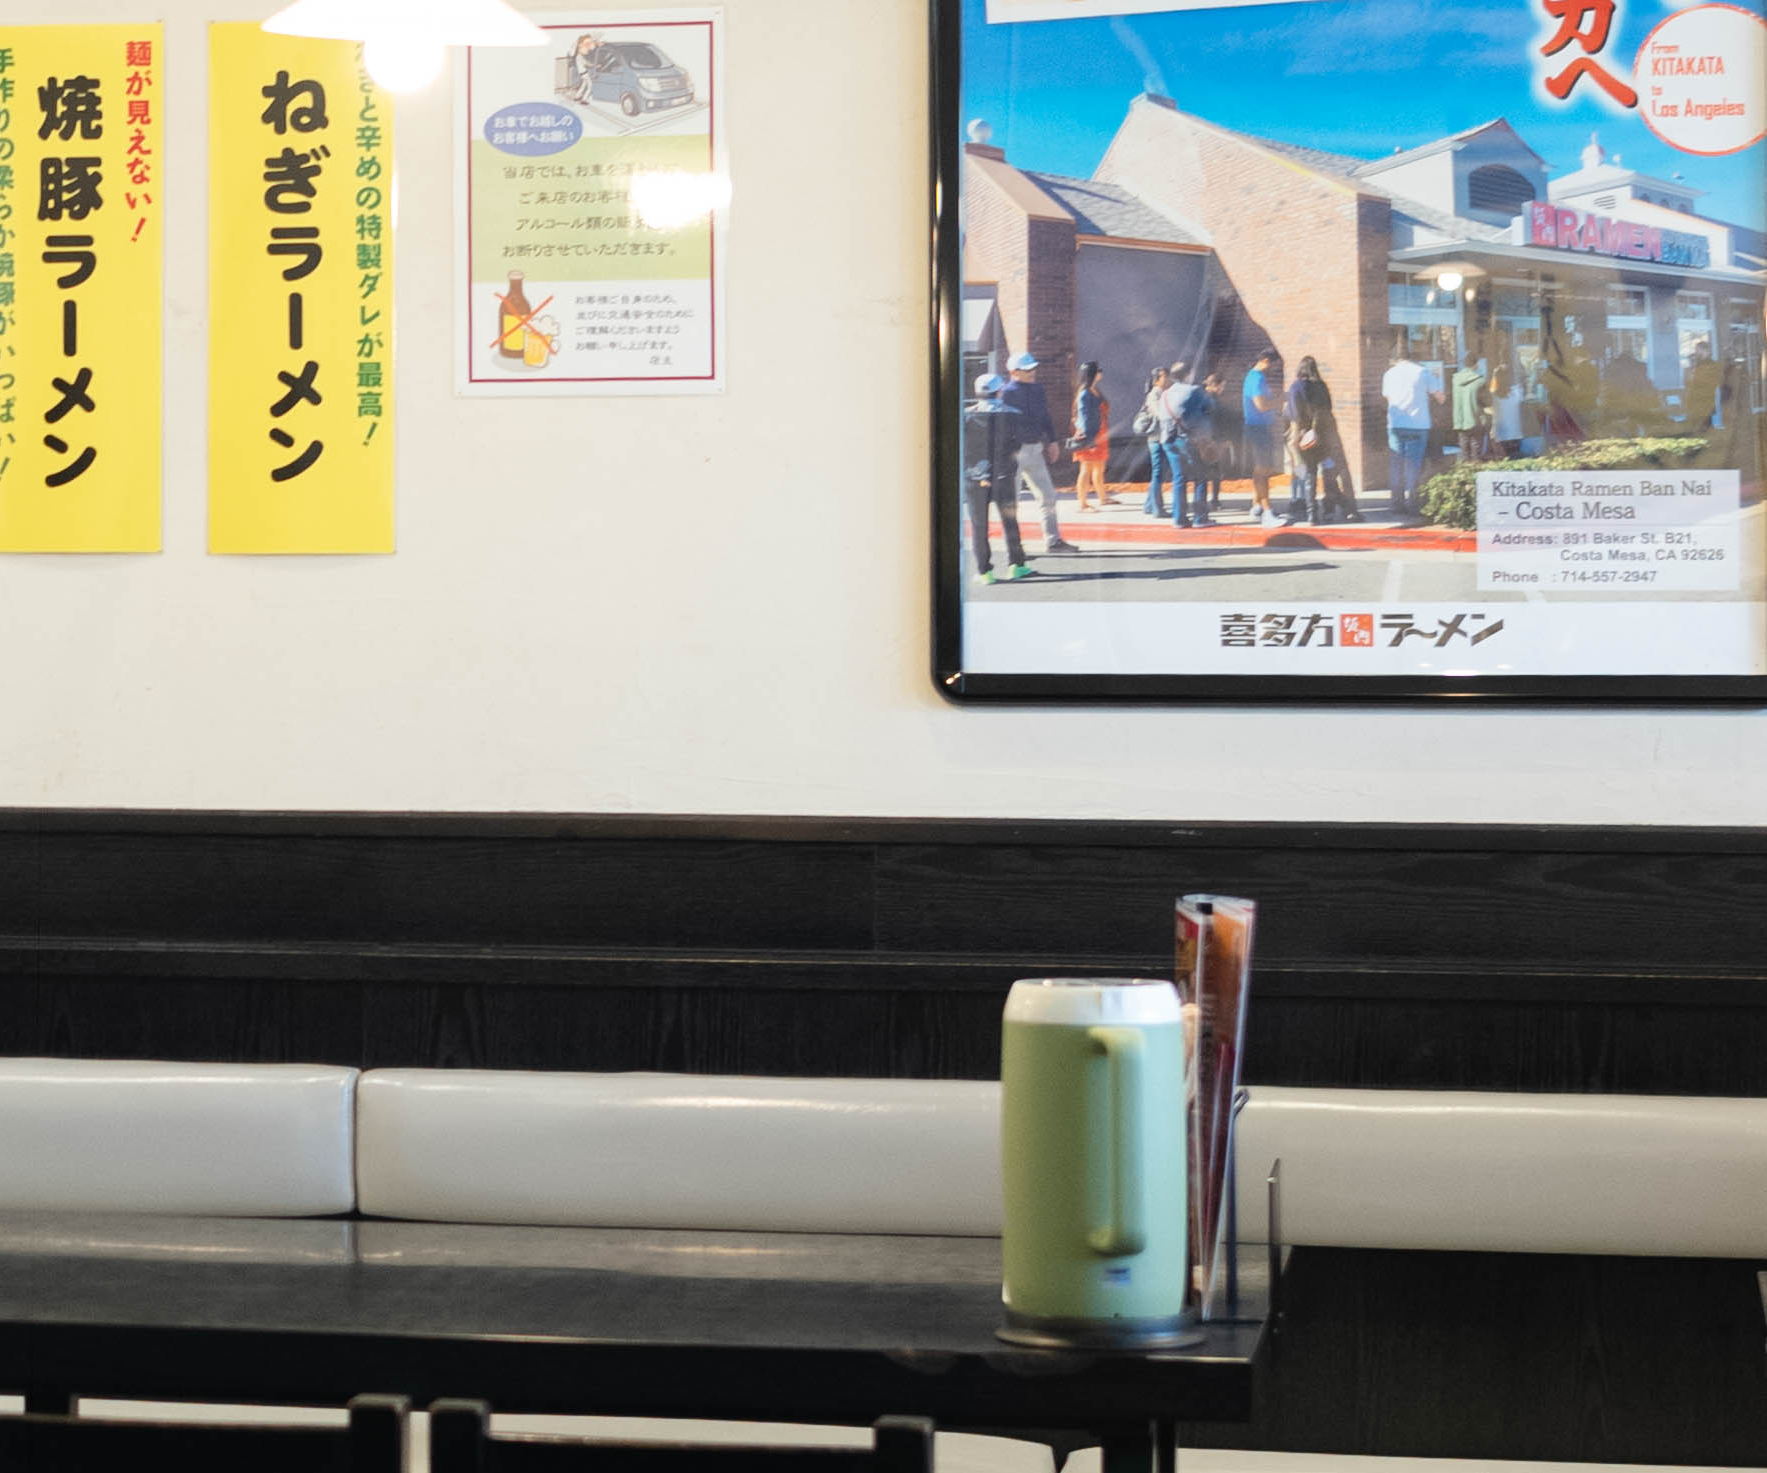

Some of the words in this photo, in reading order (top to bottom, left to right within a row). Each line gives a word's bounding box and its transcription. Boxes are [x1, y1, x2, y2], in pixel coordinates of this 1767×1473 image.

[1651, 42, 1680, 53] From
[1651, 56, 1725, 76] KITAKATA
[1651, 99, 1679, 117] Los
[1684, 98, 1746, 120] Angeles
[1558, 208, 1662, 259] RAMEN
[354, 40, 384, 447] と辛めの特製ダレが最高！
[261, 69, 332, 483] ねぎラーメン
[1491, 481, 1565, 497] Kitakata
[1571, 481, 1633, 497] Ramen
[1640, 480, 1675, 496] Ban
[1681, 480, 1712, 497] Nai
[1516, 502, 1574, 520] Costa
[1582, 502, 1635, 519] Mesa
[1491, 533, 1558, 545] Address:
[1594, 532, 1635, 544] Baker
[1560, 549, 1603, 561] Costa
[1608, 549, 1650, 563] Mesa,
[1655, 549, 1676, 561] CA
[1680, 549, 1725, 561] 92626
[1492, 571, 1539, 583] Phone
[1561, 570, 1657, 583] 714-557-2947
[1219, 613, 1334, 647] 喜多方
[1380, 613, 1504, 647] ラーメン
